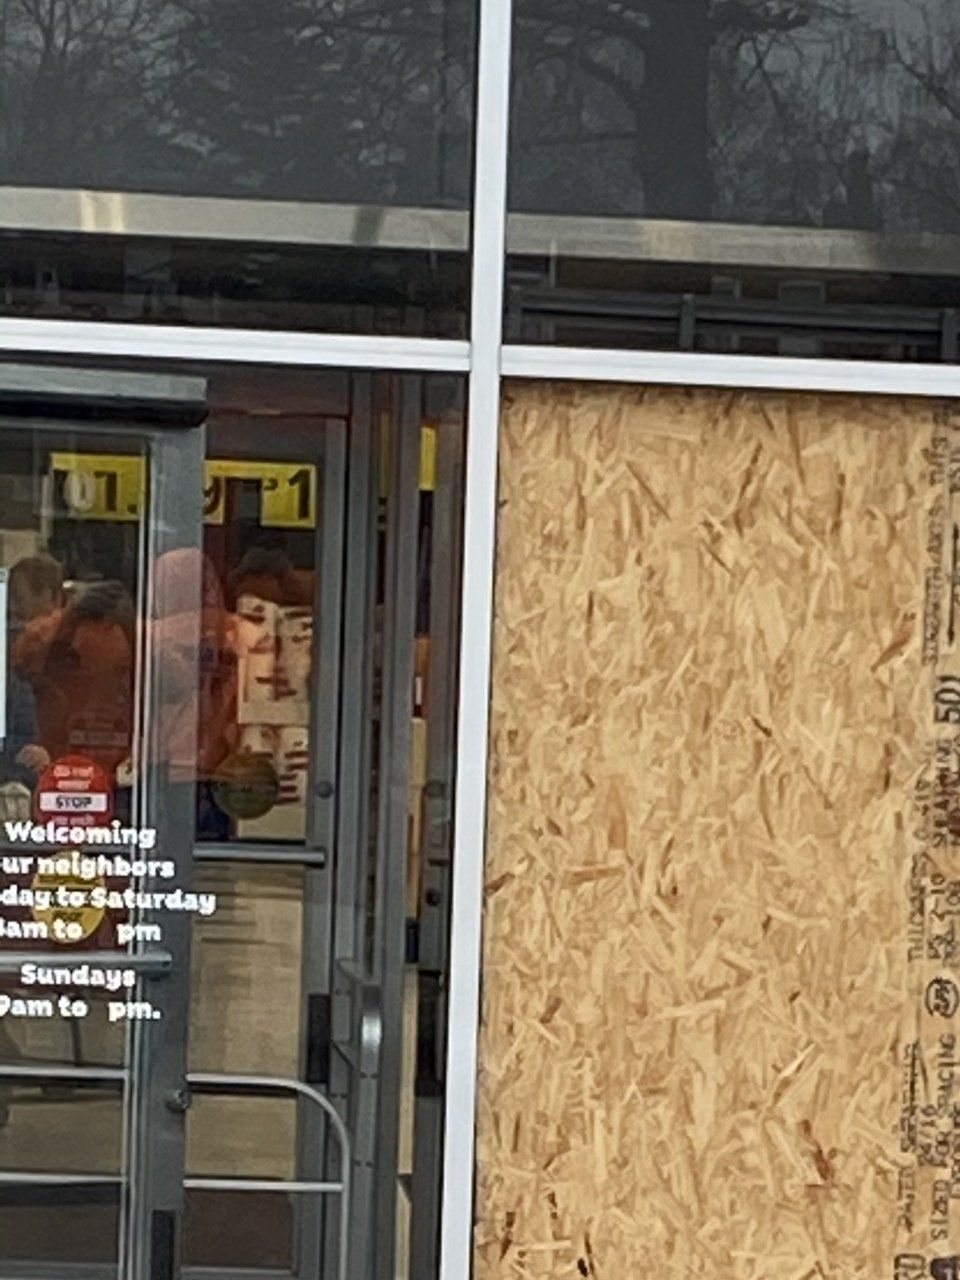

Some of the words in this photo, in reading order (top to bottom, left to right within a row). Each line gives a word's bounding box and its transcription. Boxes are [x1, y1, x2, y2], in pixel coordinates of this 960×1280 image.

[55, 796, 92, 809] STOP
[5, 820, 156, 848] Welcoming
[0, 858, 33, 873] ur
[37, 851, 175, 879] neighbors
[0, 885, 51, 909] day
[56, 886, 85, 908] to
[90, 887, 216, 915] Saturday
[54, 918, 82, 939] to
[117, 922, 161, 945] pm
[20, 963, 136, 991] Sundays
[58, 994, 88, 1017] to
[108, 999, 161, 1022] pm.
